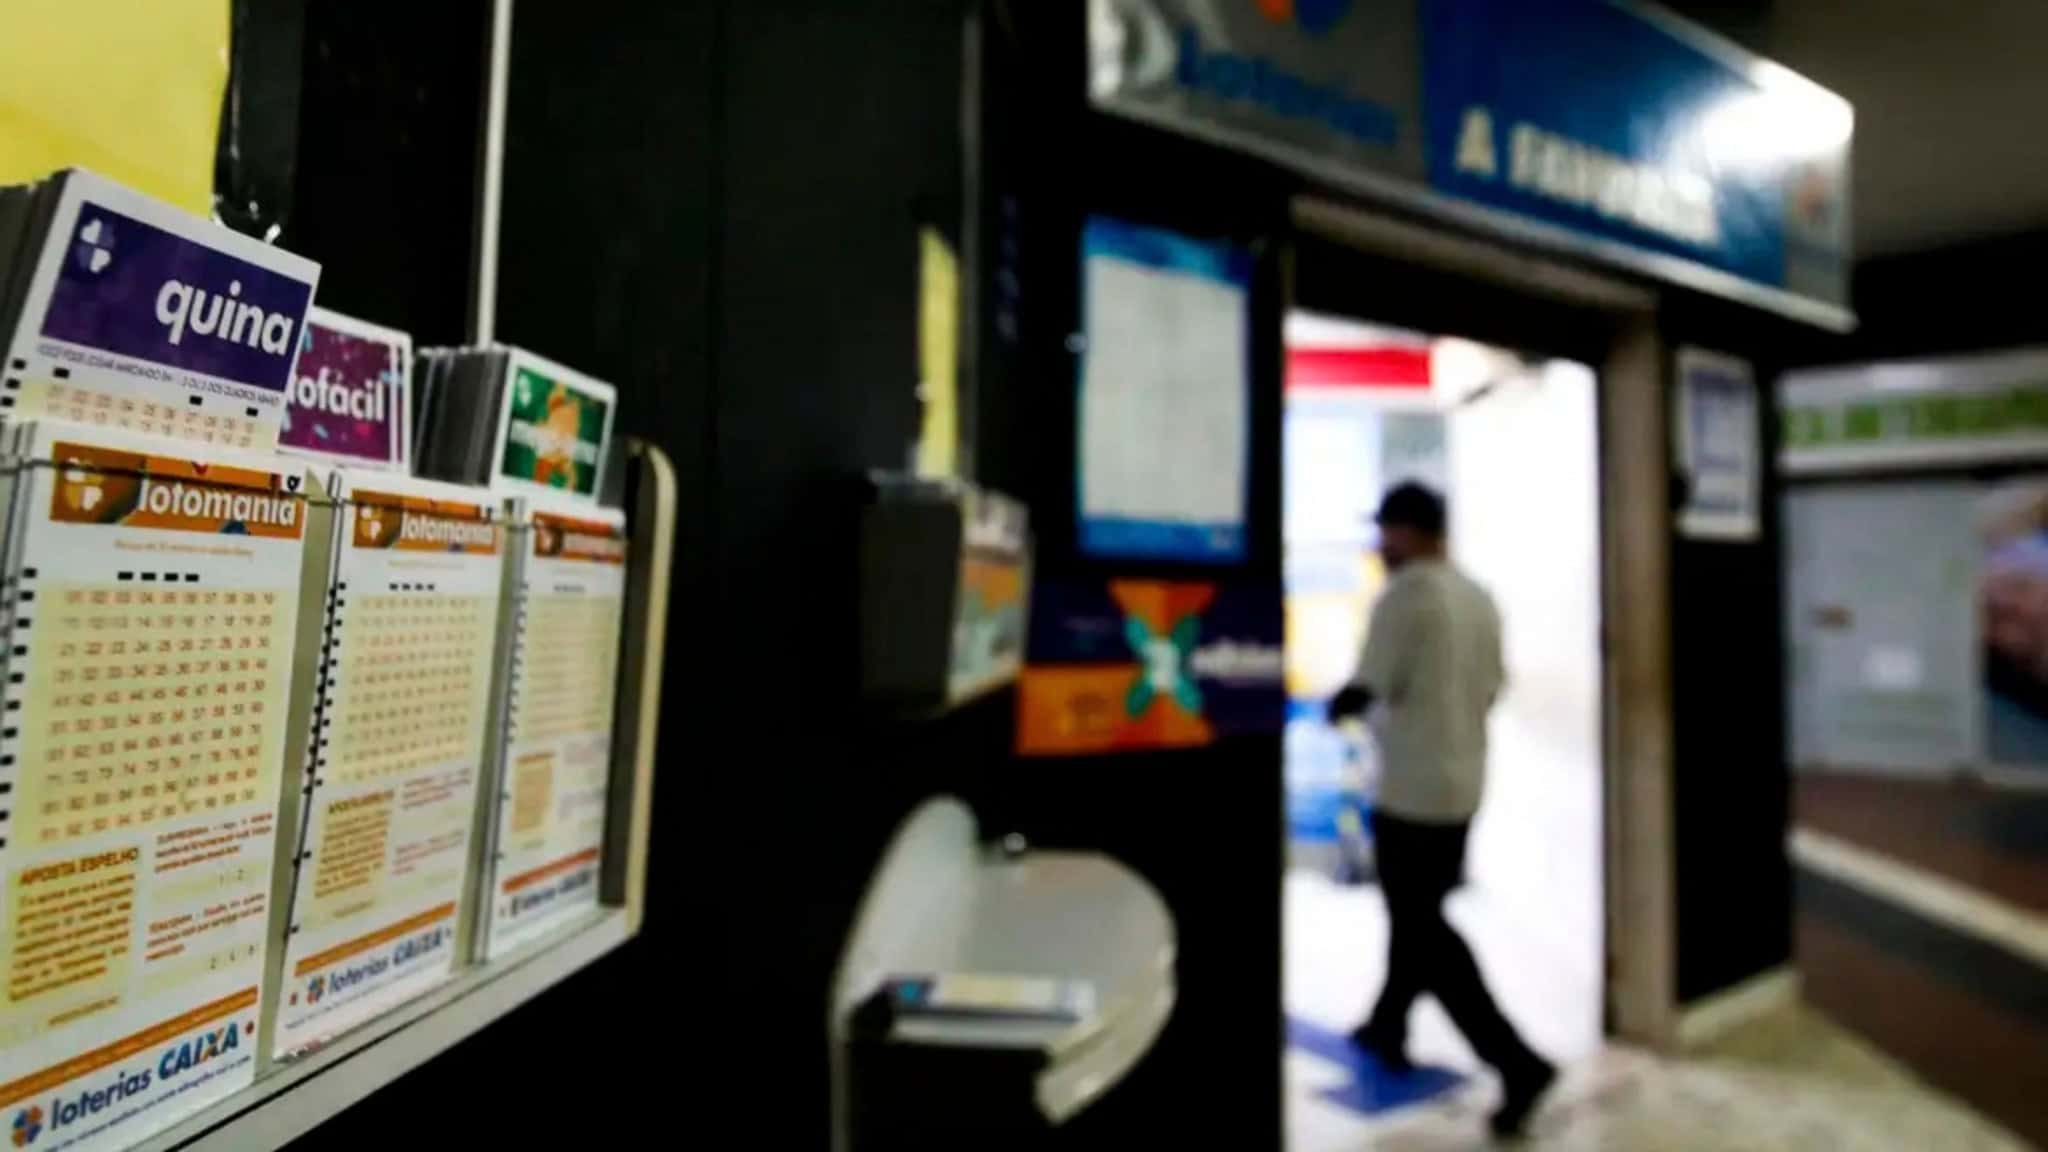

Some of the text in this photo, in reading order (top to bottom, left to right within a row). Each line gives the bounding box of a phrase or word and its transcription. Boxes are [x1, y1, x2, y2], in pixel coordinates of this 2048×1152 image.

[1455, 107, 1496, 174] A
[155, 279, 294, 357] quina
[138, 477, 296, 526] lotomania
[400, 511, 495, 545] lotomania
[51, 1068, 152, 1130] loterias
[158, 1022, 239, 1080] CAIXA
